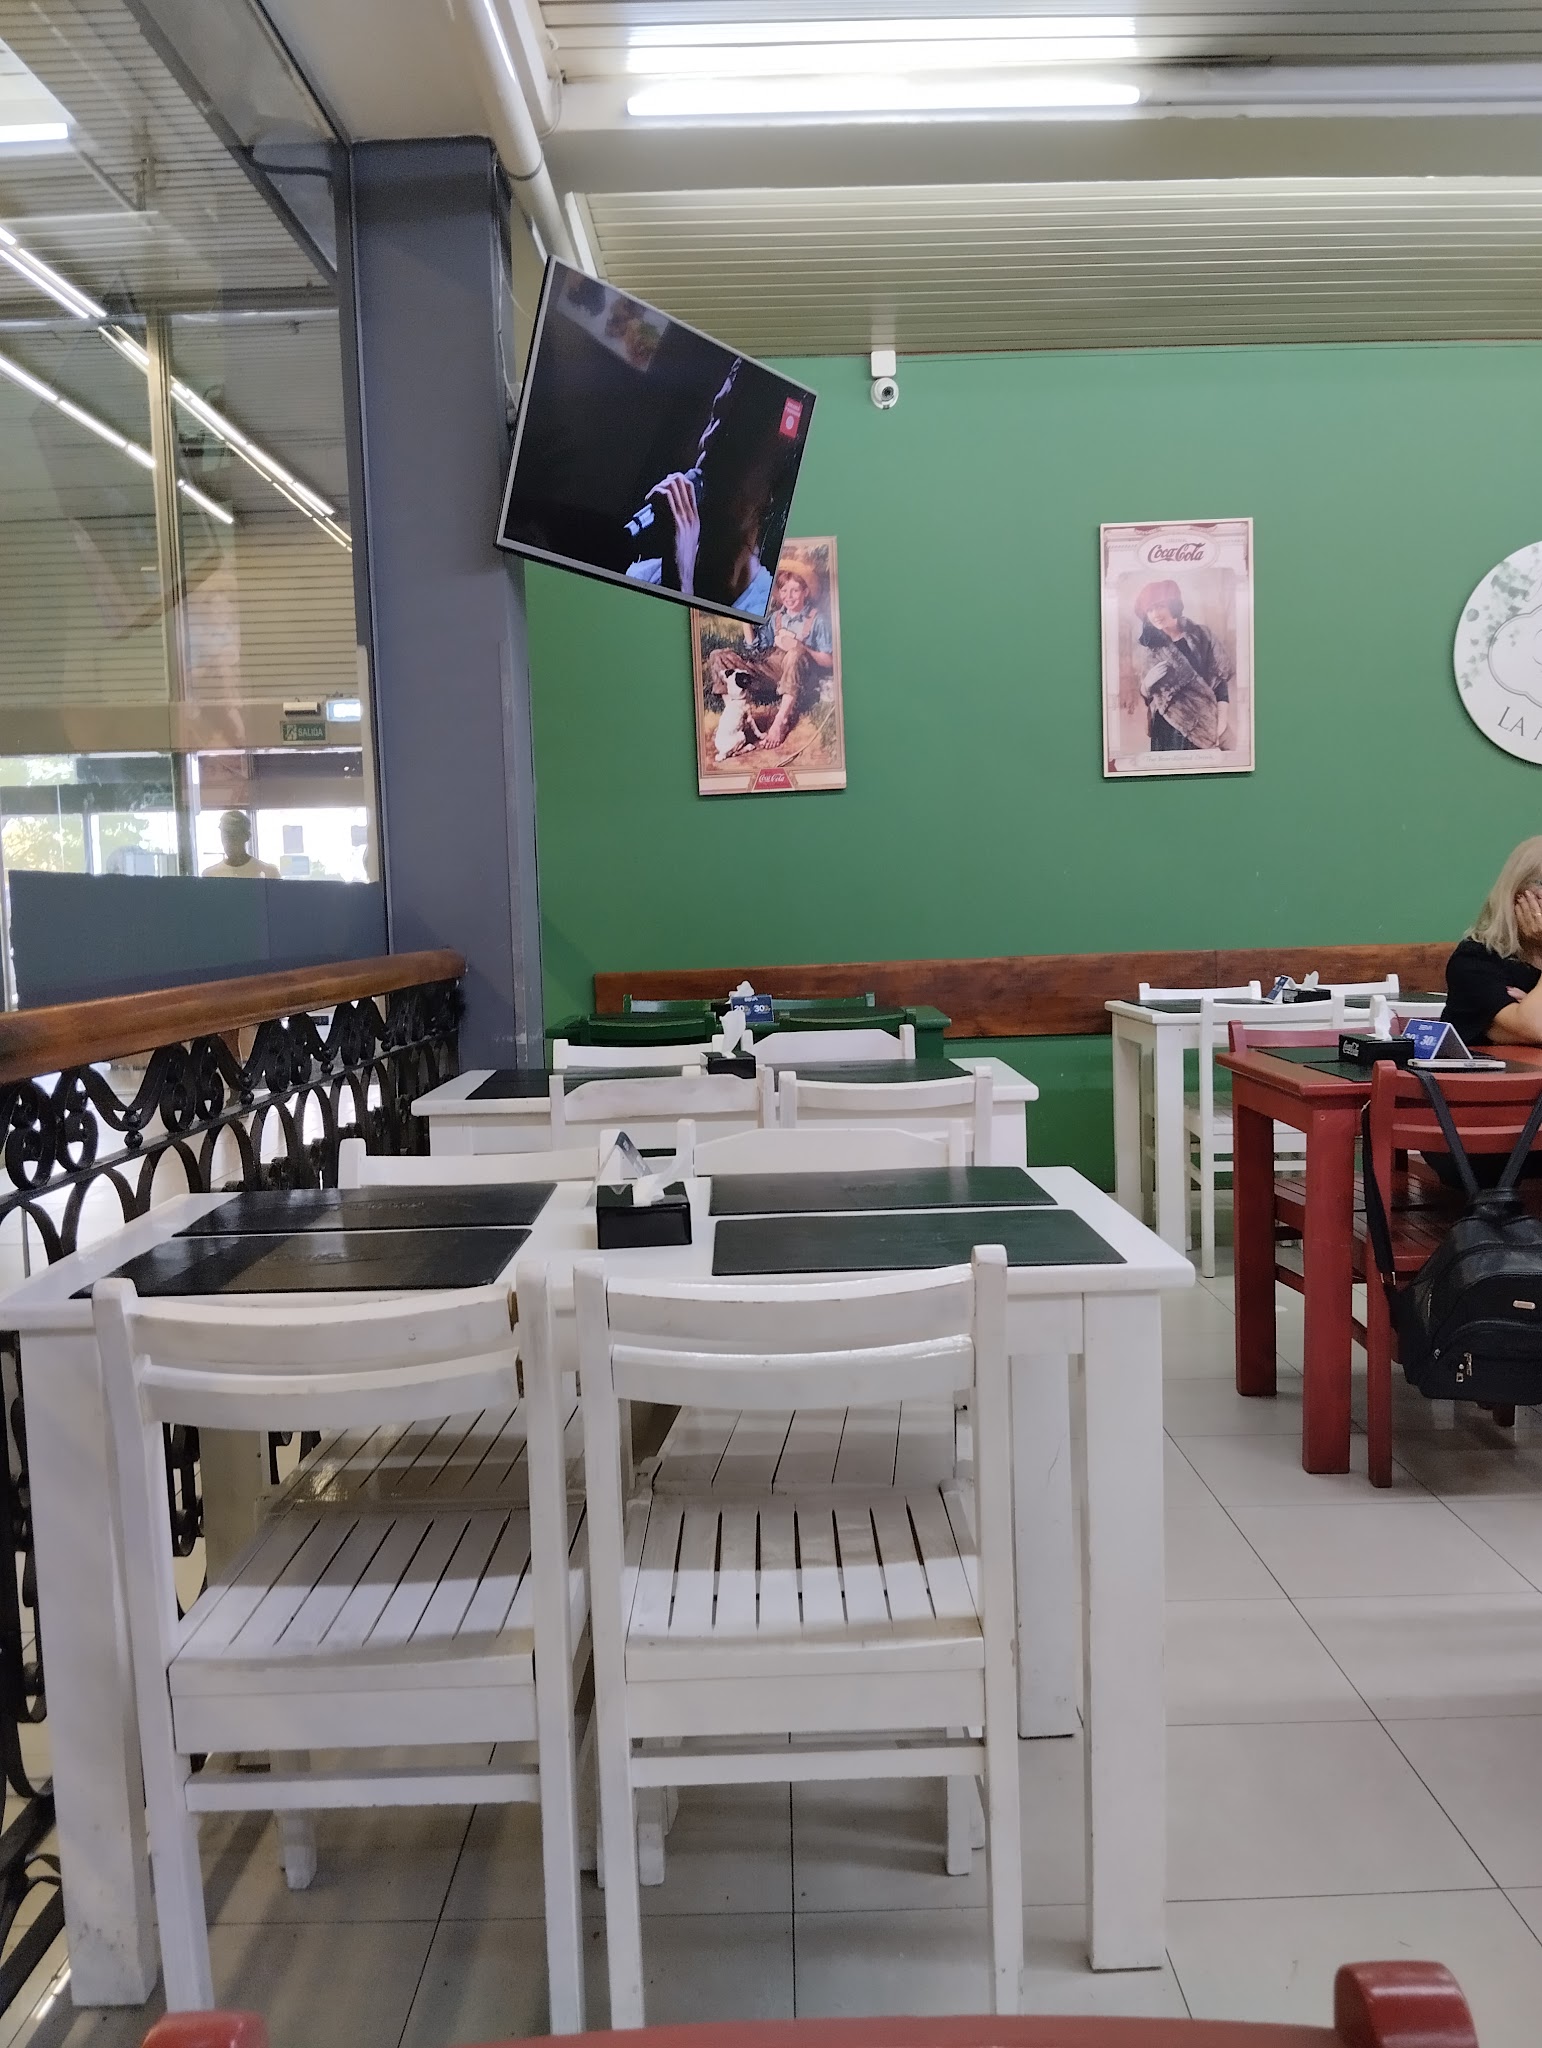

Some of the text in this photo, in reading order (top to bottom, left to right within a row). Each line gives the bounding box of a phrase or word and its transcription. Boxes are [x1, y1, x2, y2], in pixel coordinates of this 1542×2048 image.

[1147, 542, 1206, 563] Coca-Cola
[1497, 706, 1524, 736] LA
[298, 727, 323, 737] SALIDA
